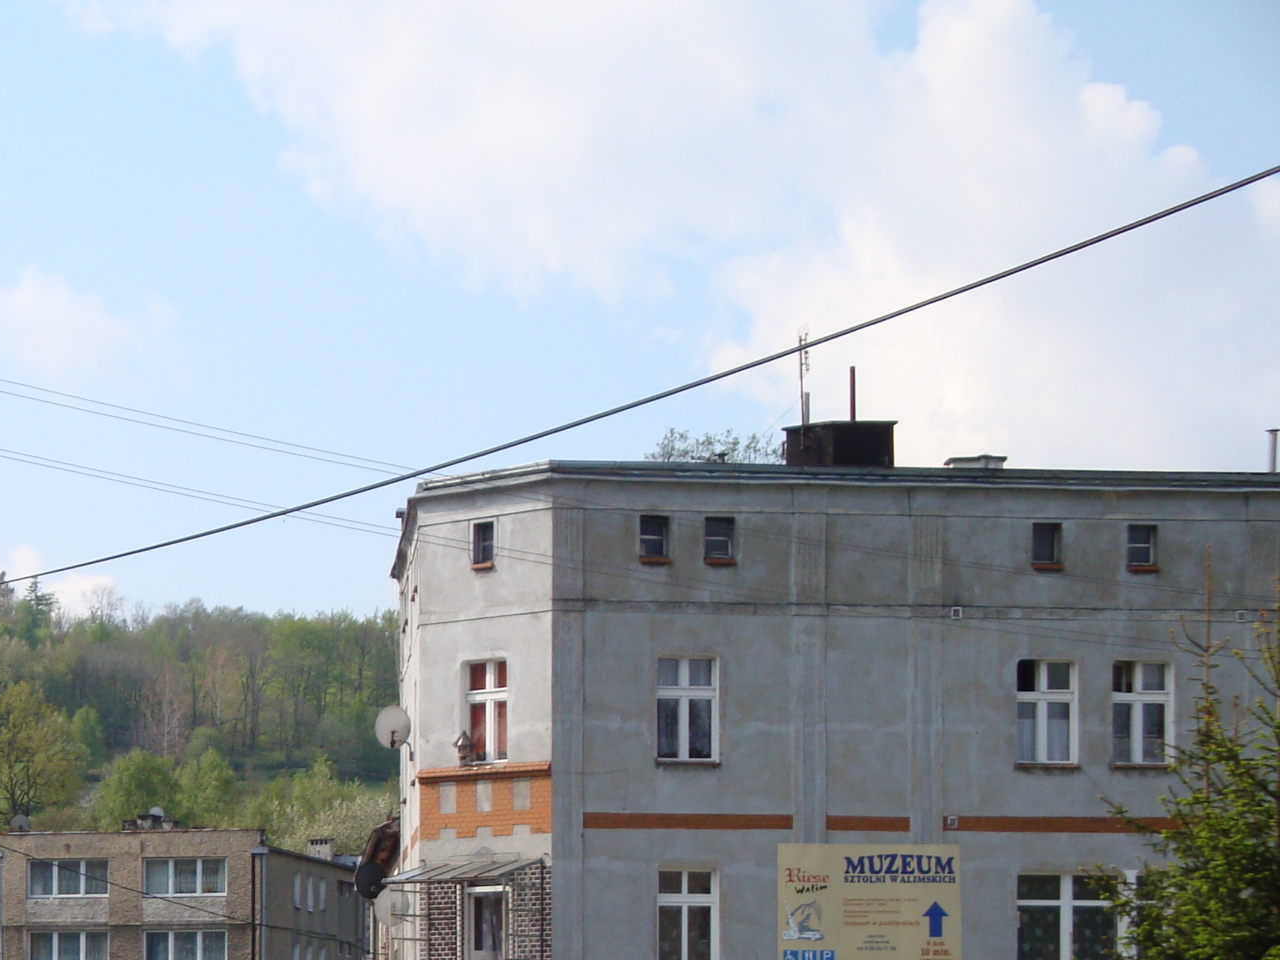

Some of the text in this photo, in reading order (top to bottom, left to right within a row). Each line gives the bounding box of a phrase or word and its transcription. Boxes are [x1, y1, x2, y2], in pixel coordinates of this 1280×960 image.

[844, 854, 955, 875] MUZEUM
[844, 875, 956, 884] SZTOLNI WALIMSKICH
[921, 947, 930, 957] 10
